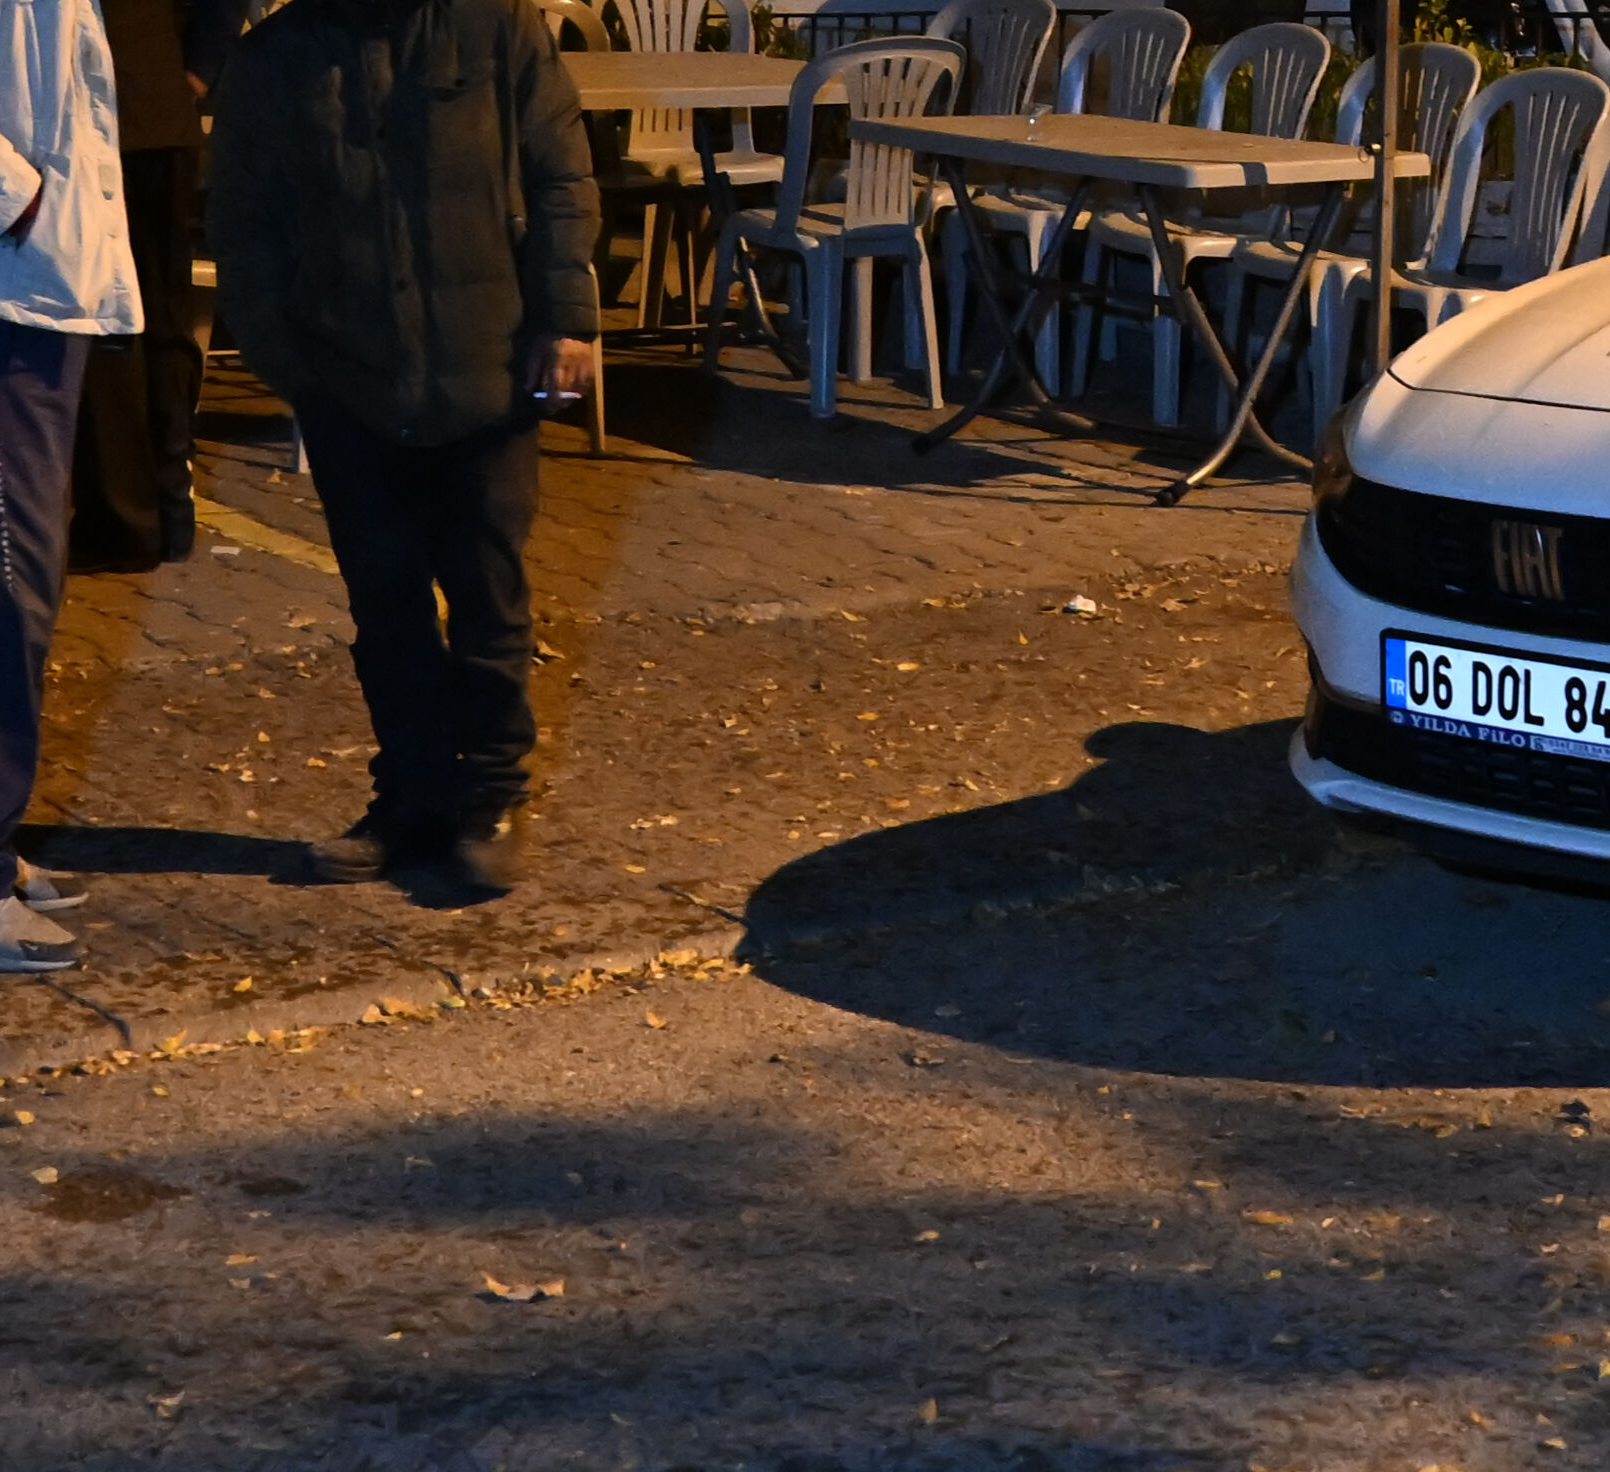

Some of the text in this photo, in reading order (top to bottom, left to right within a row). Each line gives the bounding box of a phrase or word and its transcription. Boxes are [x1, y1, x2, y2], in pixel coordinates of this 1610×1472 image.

[1491, 519, 1566, 601] FIAT
[1389, 677, 1406, 698] TR
[1408, 649, 1453, 710] 06
[1472, 660, 1545, 727] DOL
[1409, 712, 1472, 739] YILDA
